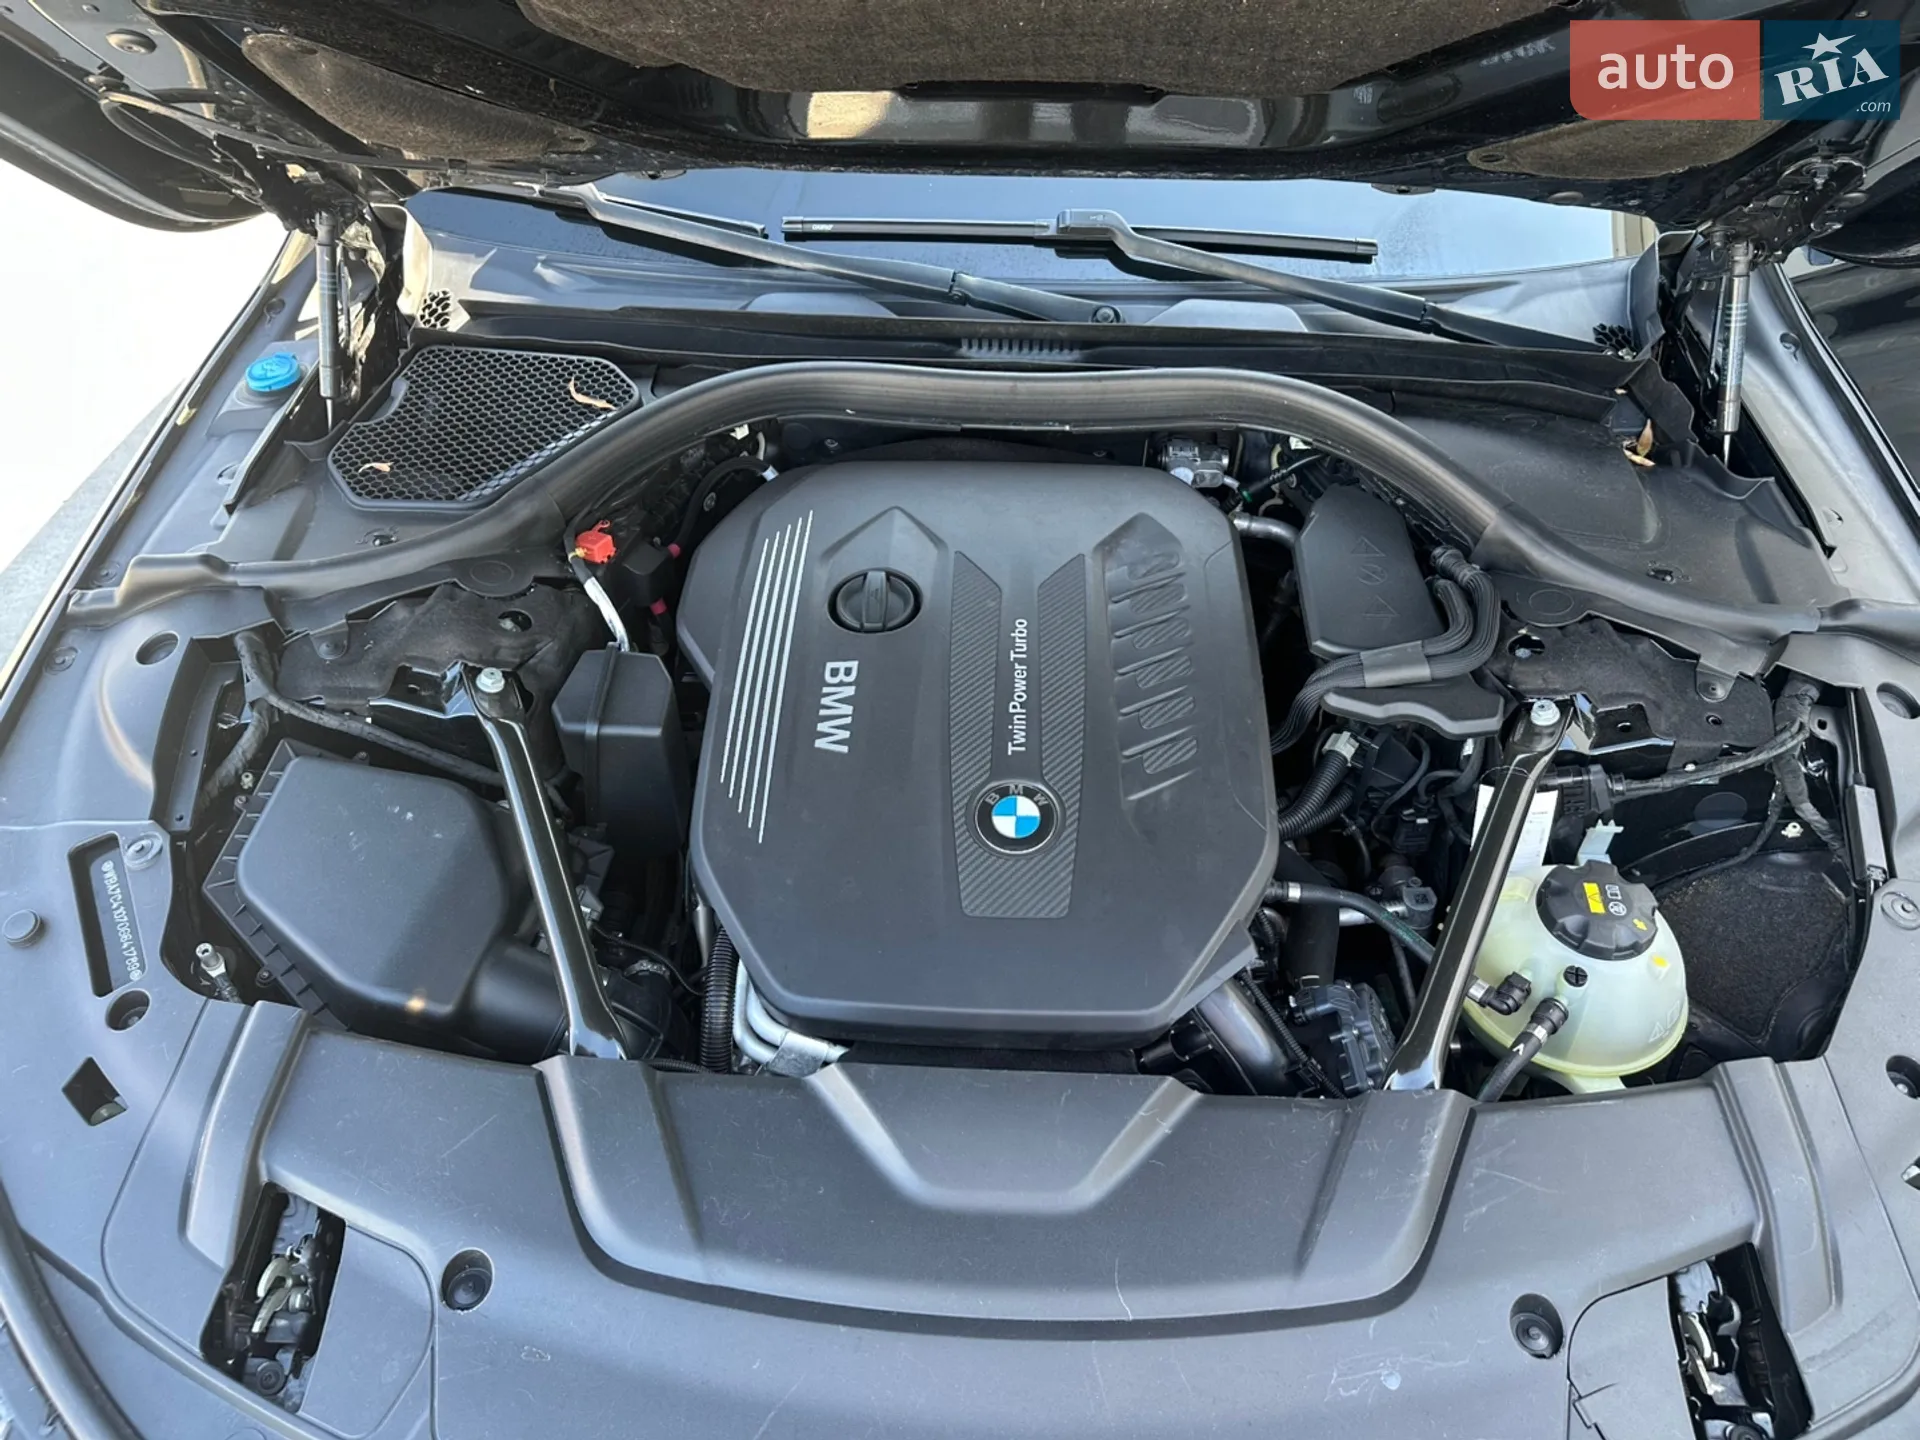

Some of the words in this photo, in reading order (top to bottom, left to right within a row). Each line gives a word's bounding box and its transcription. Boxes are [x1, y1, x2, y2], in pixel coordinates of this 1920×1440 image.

[1010, 618, 1028, 661] Turbo
[814, 660, 859, 753] BMW
[1008, 664, 1028, 755] TwinPower
